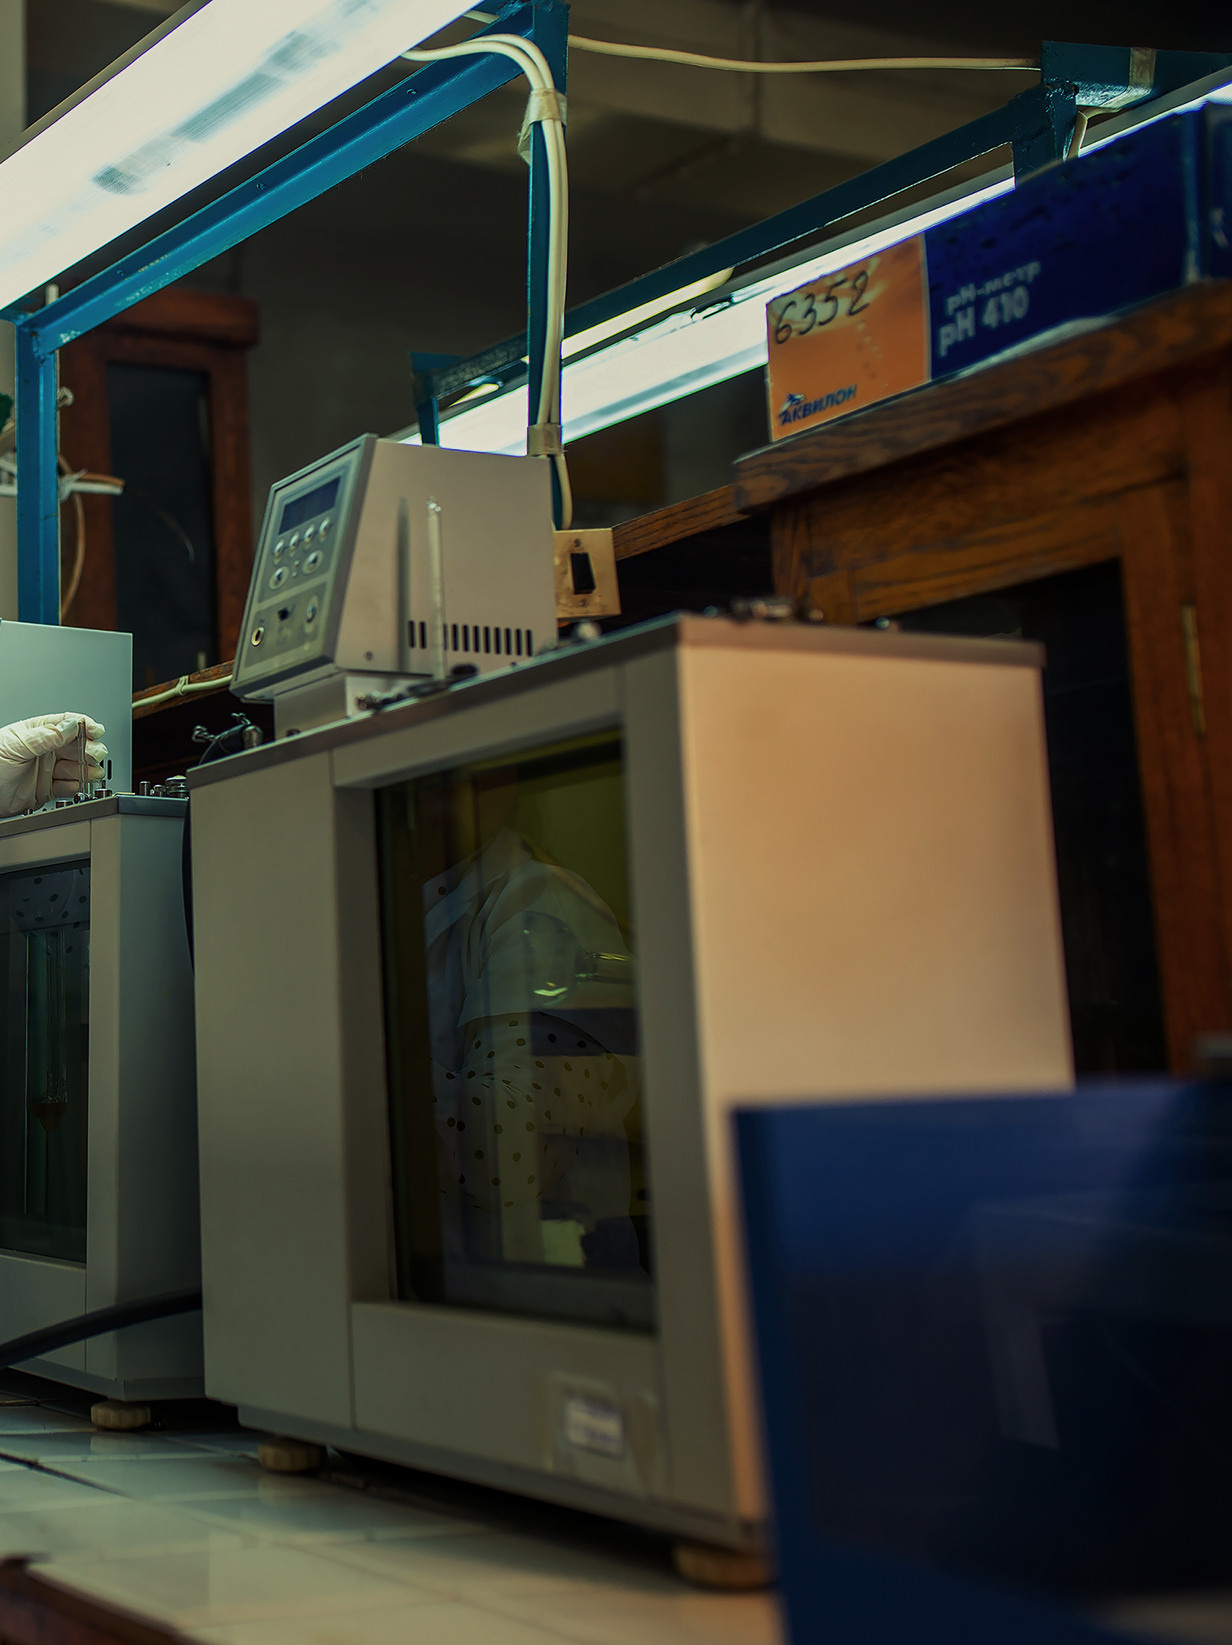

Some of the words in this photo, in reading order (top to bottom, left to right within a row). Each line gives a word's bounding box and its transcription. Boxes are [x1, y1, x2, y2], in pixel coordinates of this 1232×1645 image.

[775, 270, 870, 345] 6352
[939, 306, 976, 357] pH
[981, 286, 1030, 328] 410
[781, 384, 858, 425] АКВИЛОН
